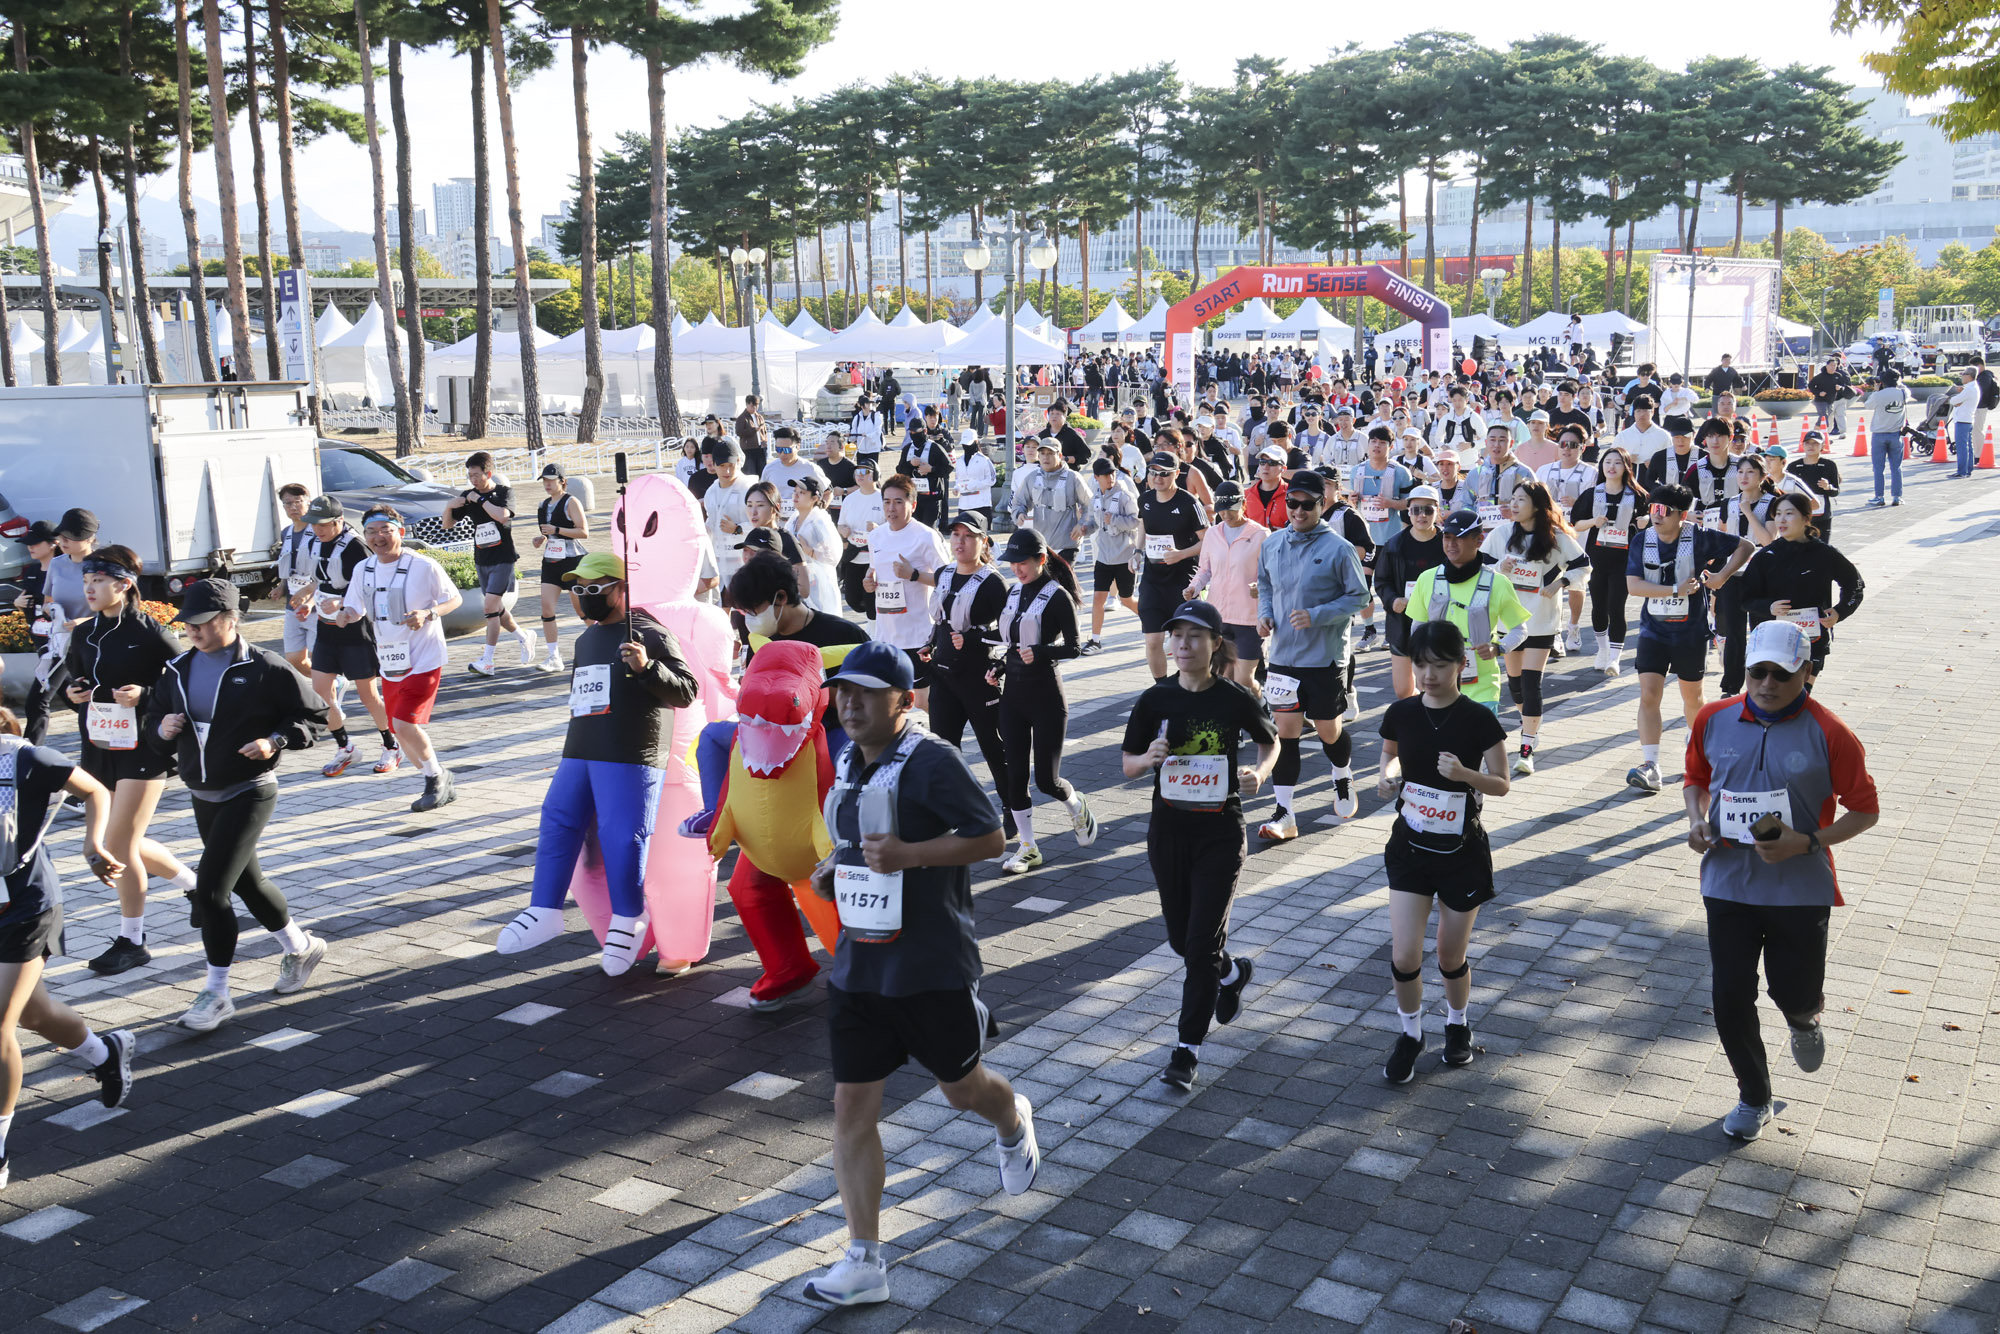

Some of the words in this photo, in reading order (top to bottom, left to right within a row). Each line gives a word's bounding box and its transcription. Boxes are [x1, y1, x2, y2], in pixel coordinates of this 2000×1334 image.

[283, 275, 294, 296] E
[1194, 280, 1241, 318] START
[1385, 278, 1435, 314] FINISH
[1881, 290, 1889, 299] F
[1528, 336, 1547, 346] MC
[239, 572, 260, 583] 3008
[1513, 567, 1538, 578] 2024
[881, 591, 900, 600] 1832
[1660, 598, 1684, 606] 1457
[386, 653, 406, 662] 1260
[579, 681, 604, 695] 1326
[1270, 686, 1292, 697] 1377
[100, 719, 130, 730] 2146
[1168, 775, 1179, 784] W
[1181, 773, 1219, 787] 2041
[1418, 804, 1457, 822] 2040
[1726, 812, 1736, 822] M
[840, 892, 848, 903] M
[850, 891, 890, 910] 1571
